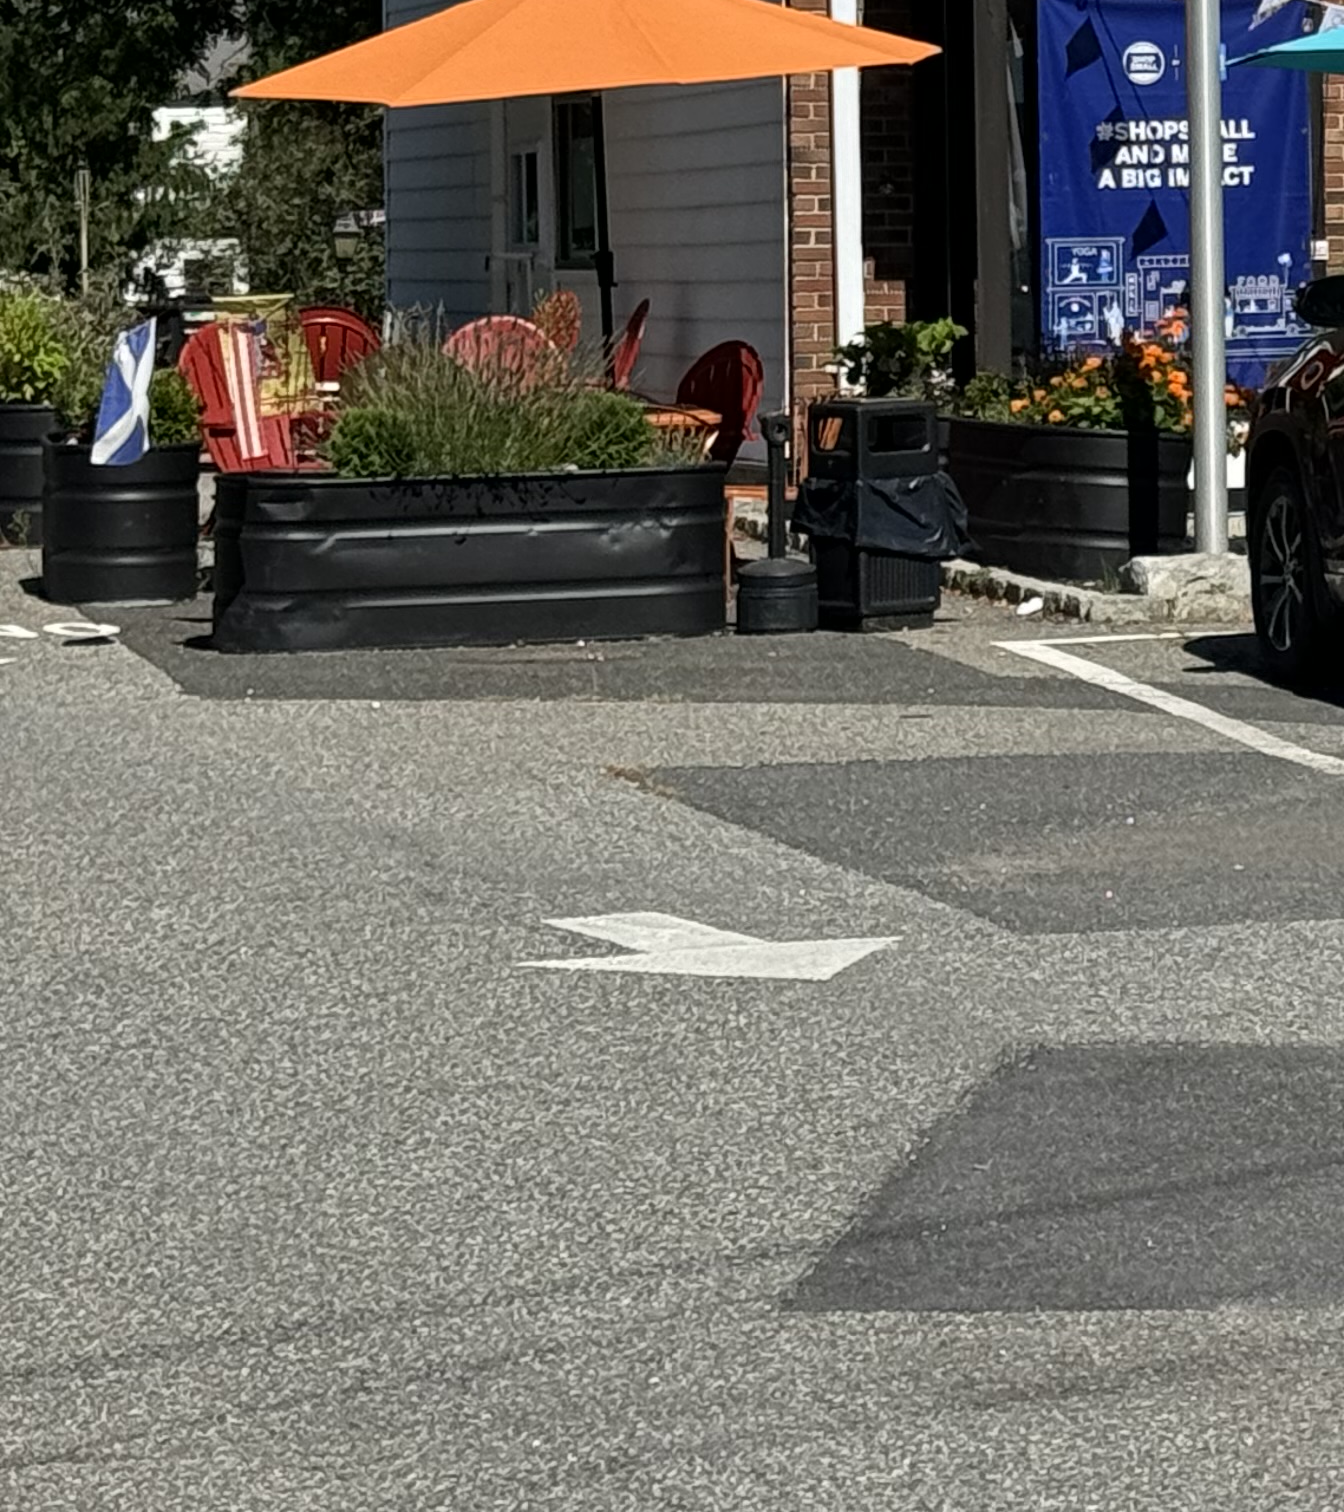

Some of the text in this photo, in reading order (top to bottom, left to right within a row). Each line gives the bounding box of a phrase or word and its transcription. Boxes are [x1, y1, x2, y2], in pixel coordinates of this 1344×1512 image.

[1096, 119, 1256, 141] #SHOPSALL
[1114, 144, 1238, 166] AND ME
[1098, 166, 1255, 189] A BIG IMCT
[1071, 246, 1098, 257] YOGA
[1236, 275, 1280, 287] FOOD
